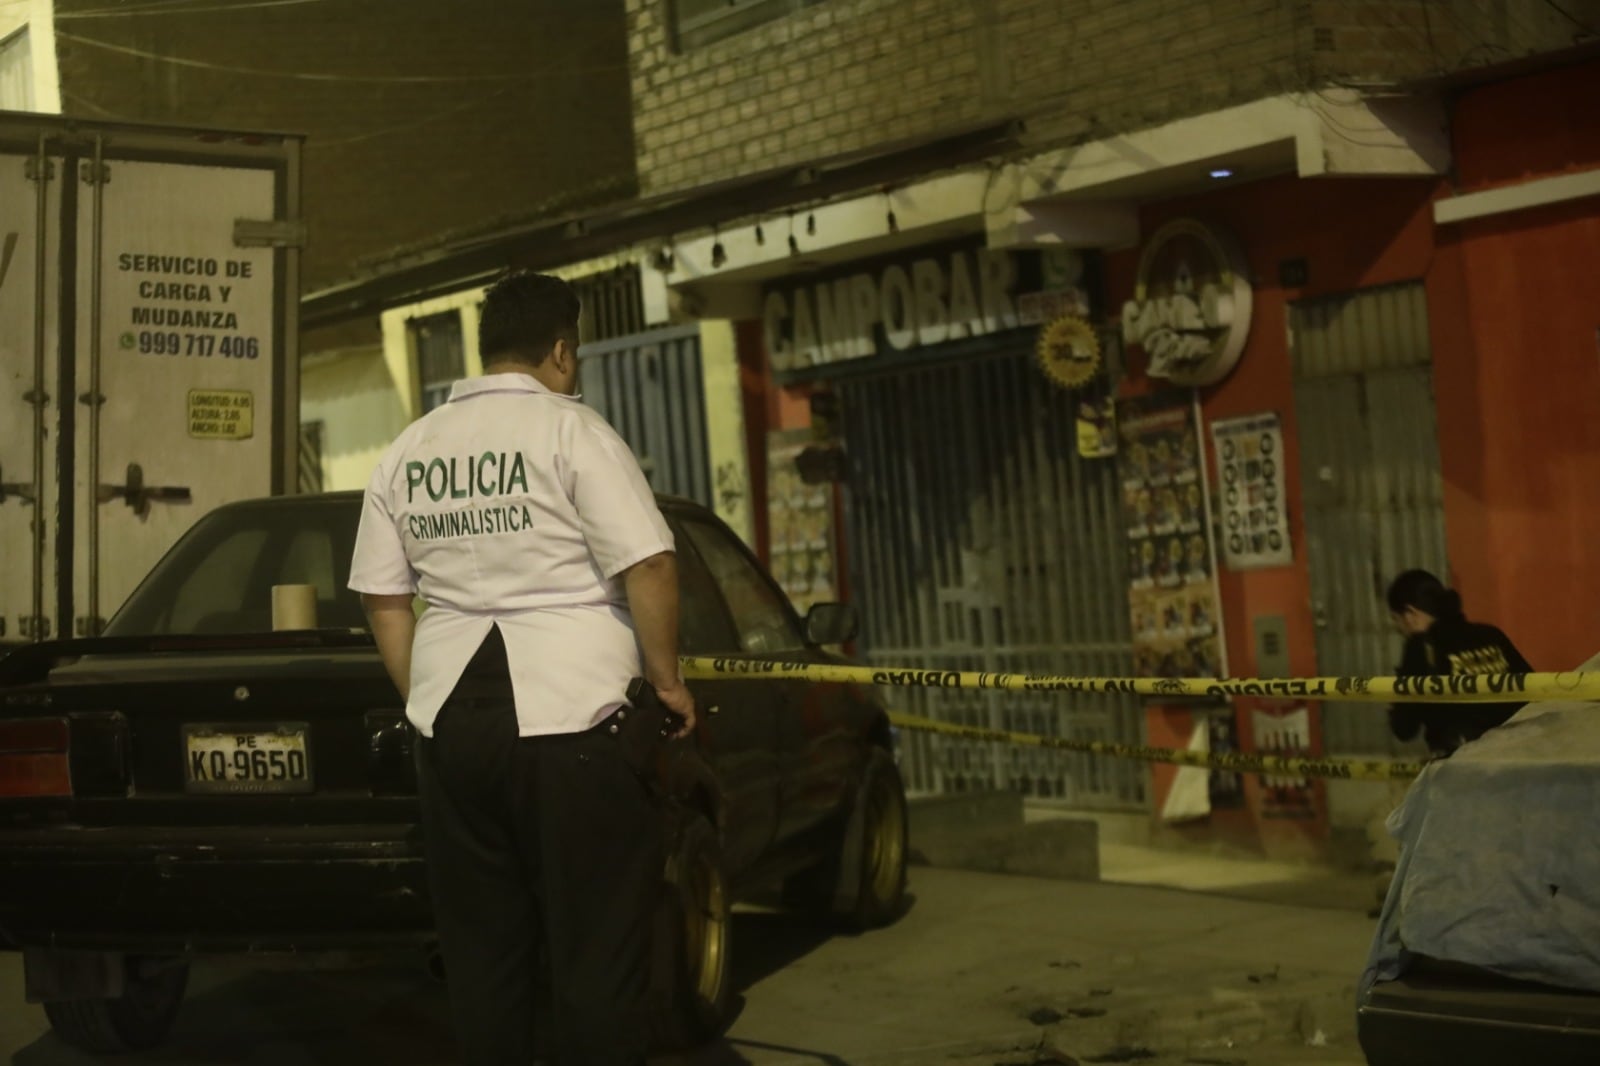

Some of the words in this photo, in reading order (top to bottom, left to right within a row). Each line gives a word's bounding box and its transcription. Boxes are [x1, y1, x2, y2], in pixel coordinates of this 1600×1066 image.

[118, 253, 218, 278] SERVICIO
[226, 261, 252, 279] DE
[139, 280, 212, 302] CARGA
[218, 286, 232, 303] Y
[132, 307, 238, 330] MUDANZA
[139, 331, 181, 357] 999
[186, 334, 215, 357] 717
[219, 336, 259, 360] 406
[406, 451, 529, 504] POLICIA
[408, 505, 534, 540] CRIMINALISTICA
[235, 735, 257, 749] PE
